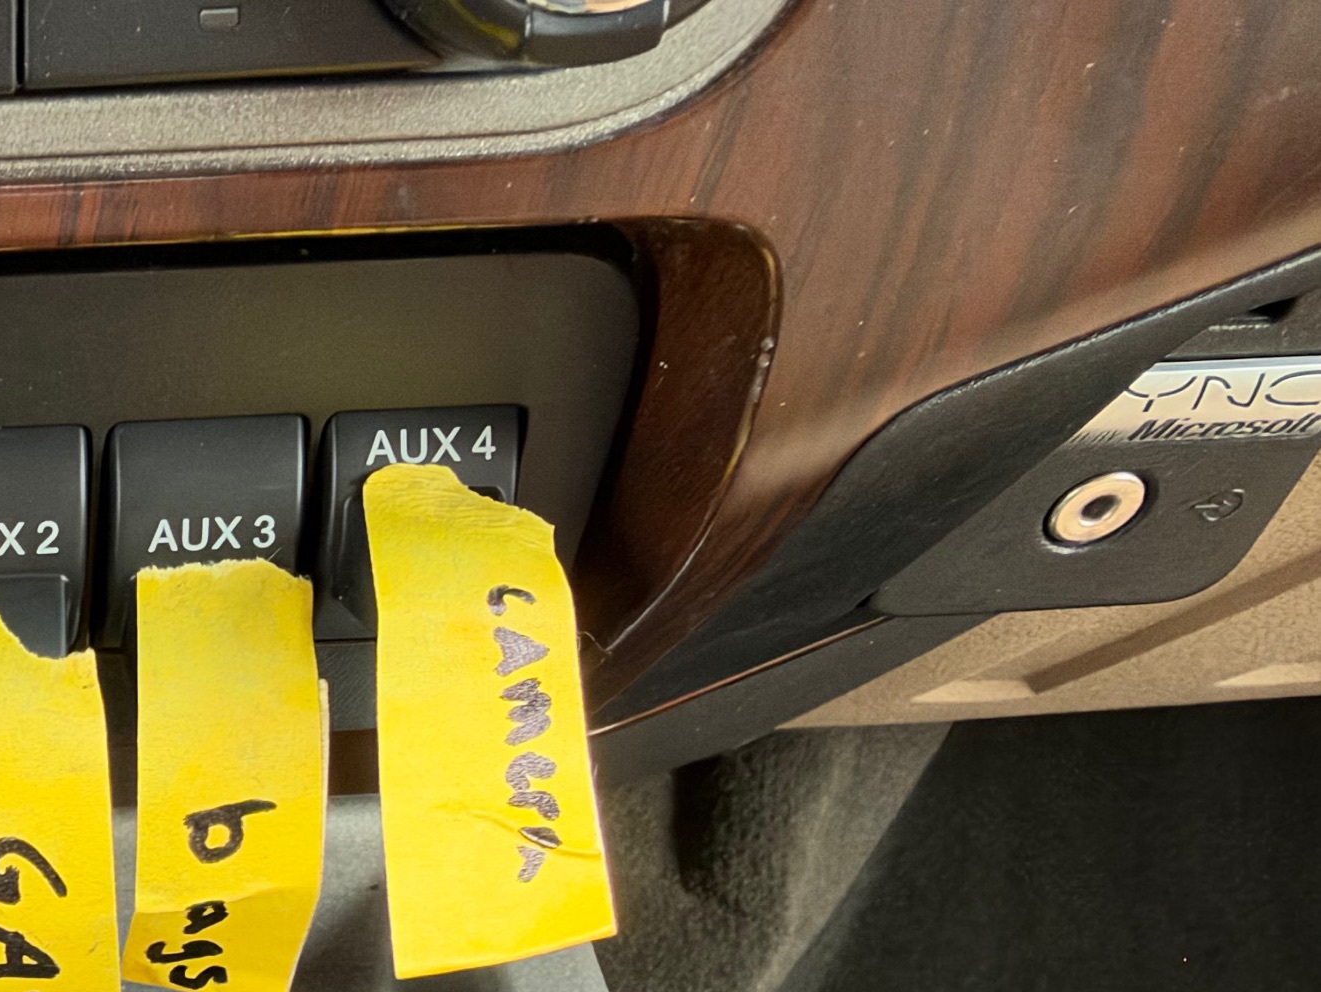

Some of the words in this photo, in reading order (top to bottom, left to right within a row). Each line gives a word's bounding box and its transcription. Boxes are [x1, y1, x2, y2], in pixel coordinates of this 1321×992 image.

[1127, 369, 1321, 413] YNC
[365, 426, 462, 466] AUX
[471, 425, 496, 461] 4
[35, 520, 59, 555] 2
[147, 515, 243, 553] AUX
[252, 514, 277, 549] 3
